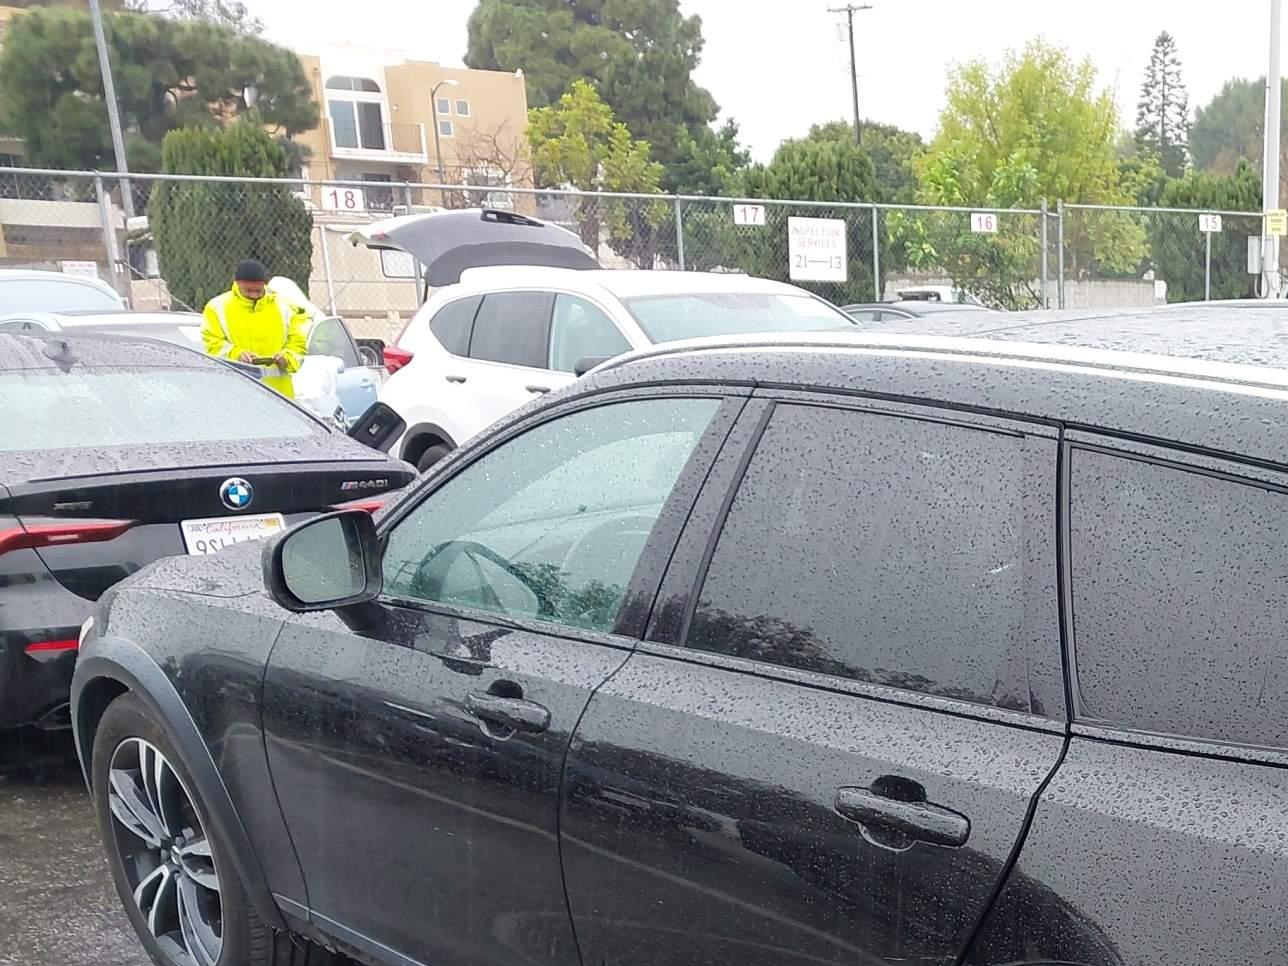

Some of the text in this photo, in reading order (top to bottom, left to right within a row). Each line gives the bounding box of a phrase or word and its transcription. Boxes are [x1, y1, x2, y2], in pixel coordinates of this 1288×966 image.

[329, 190, 355, 208] 18
[740, 206, 759, 222] 17
[977, 215, 992, 230] 16
[1204, 217, 1217, 230] 15
[791, 225, 840, 237] INSPECTION
[797, 238, 837, 248] SERVICES
